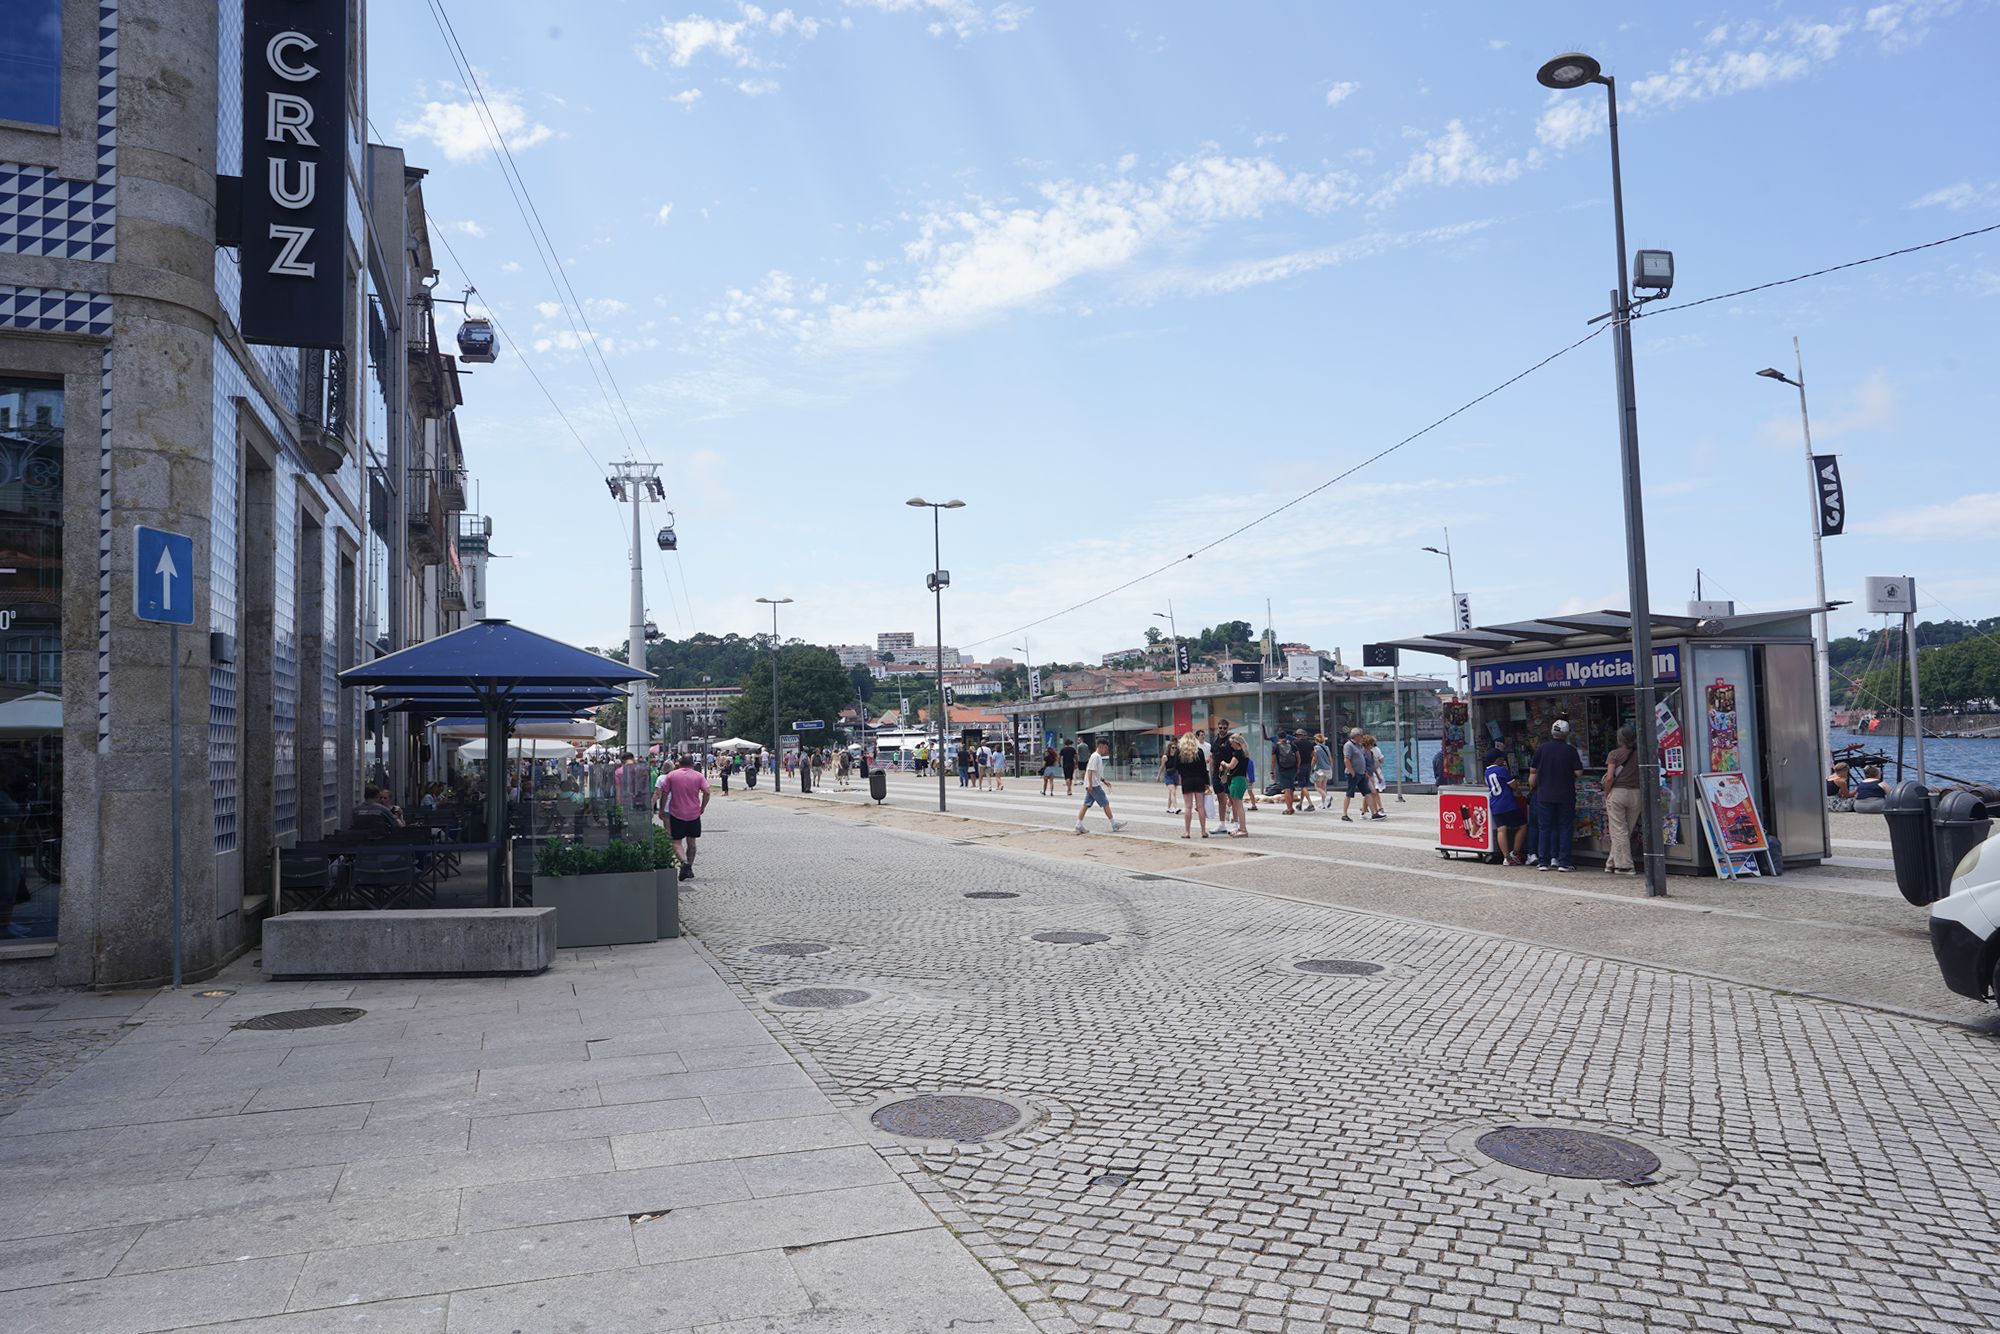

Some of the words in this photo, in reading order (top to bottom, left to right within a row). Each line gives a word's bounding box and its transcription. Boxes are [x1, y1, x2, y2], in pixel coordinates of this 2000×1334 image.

[265, 31, 320, 278] CRUZ
[1821, 463, 1840, 527] GAIA
[1179, 645, 1189, 671] GAIA
[1474, 666, 1493, 692] jn
[1496, 666, 1543, 686] Jornal
[1545, 665, 1565, 681] de
[1566, 658, 1635, 681] Notícia
